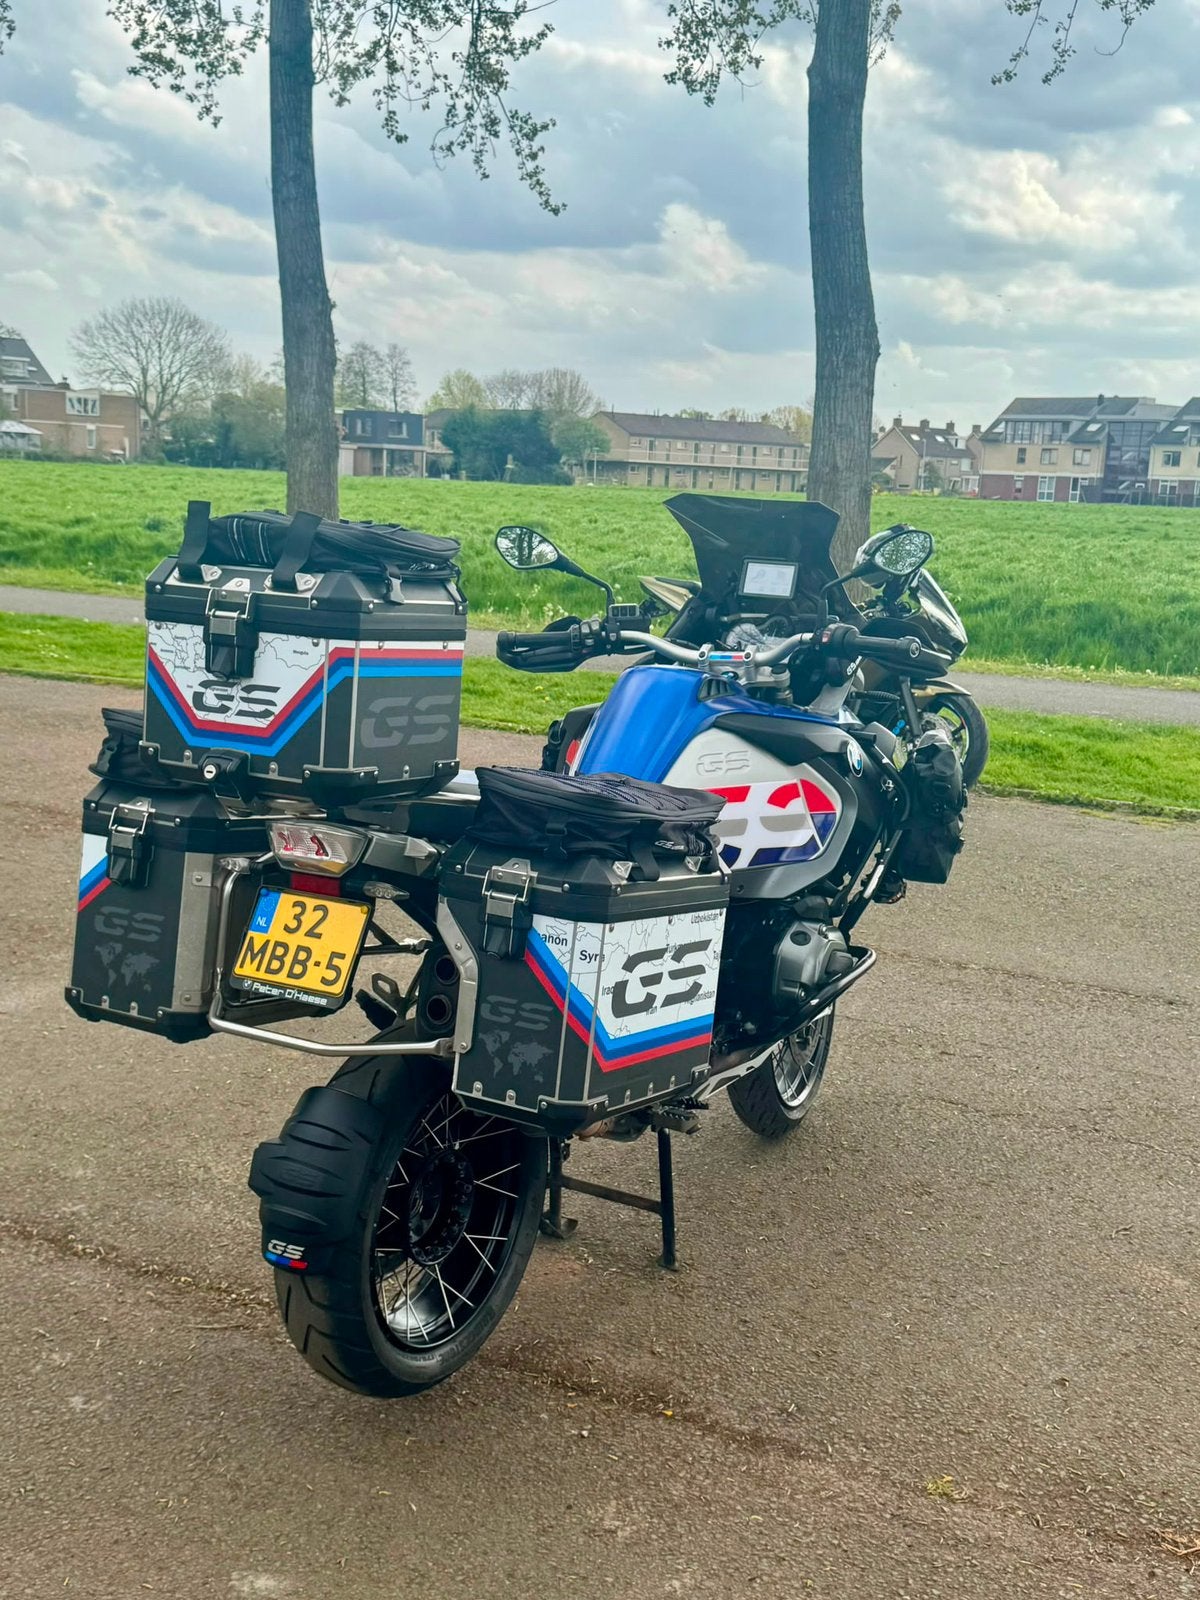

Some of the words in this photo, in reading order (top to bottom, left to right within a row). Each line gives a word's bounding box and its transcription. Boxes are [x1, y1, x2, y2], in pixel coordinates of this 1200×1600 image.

[192, 680, 281, 718] GS
[361, 694, 456, 748] GS
[696, 750, 750, 776] GS
[94, 906, 165, 942] GS
[256, 916, 267, 927] NL
[283, 900, 329, 939] 32
[540, 932, 569, 947] anon
[239, 936, 347, 987] MBB-5
[611, 939, 713, 1018] GS
[252, 982, 284, 996] Peter
[285, 988, 328, 1006] D'Haese
[480, 995, 554, 1031] GS
[268, 1239, 306, 1260] GS
